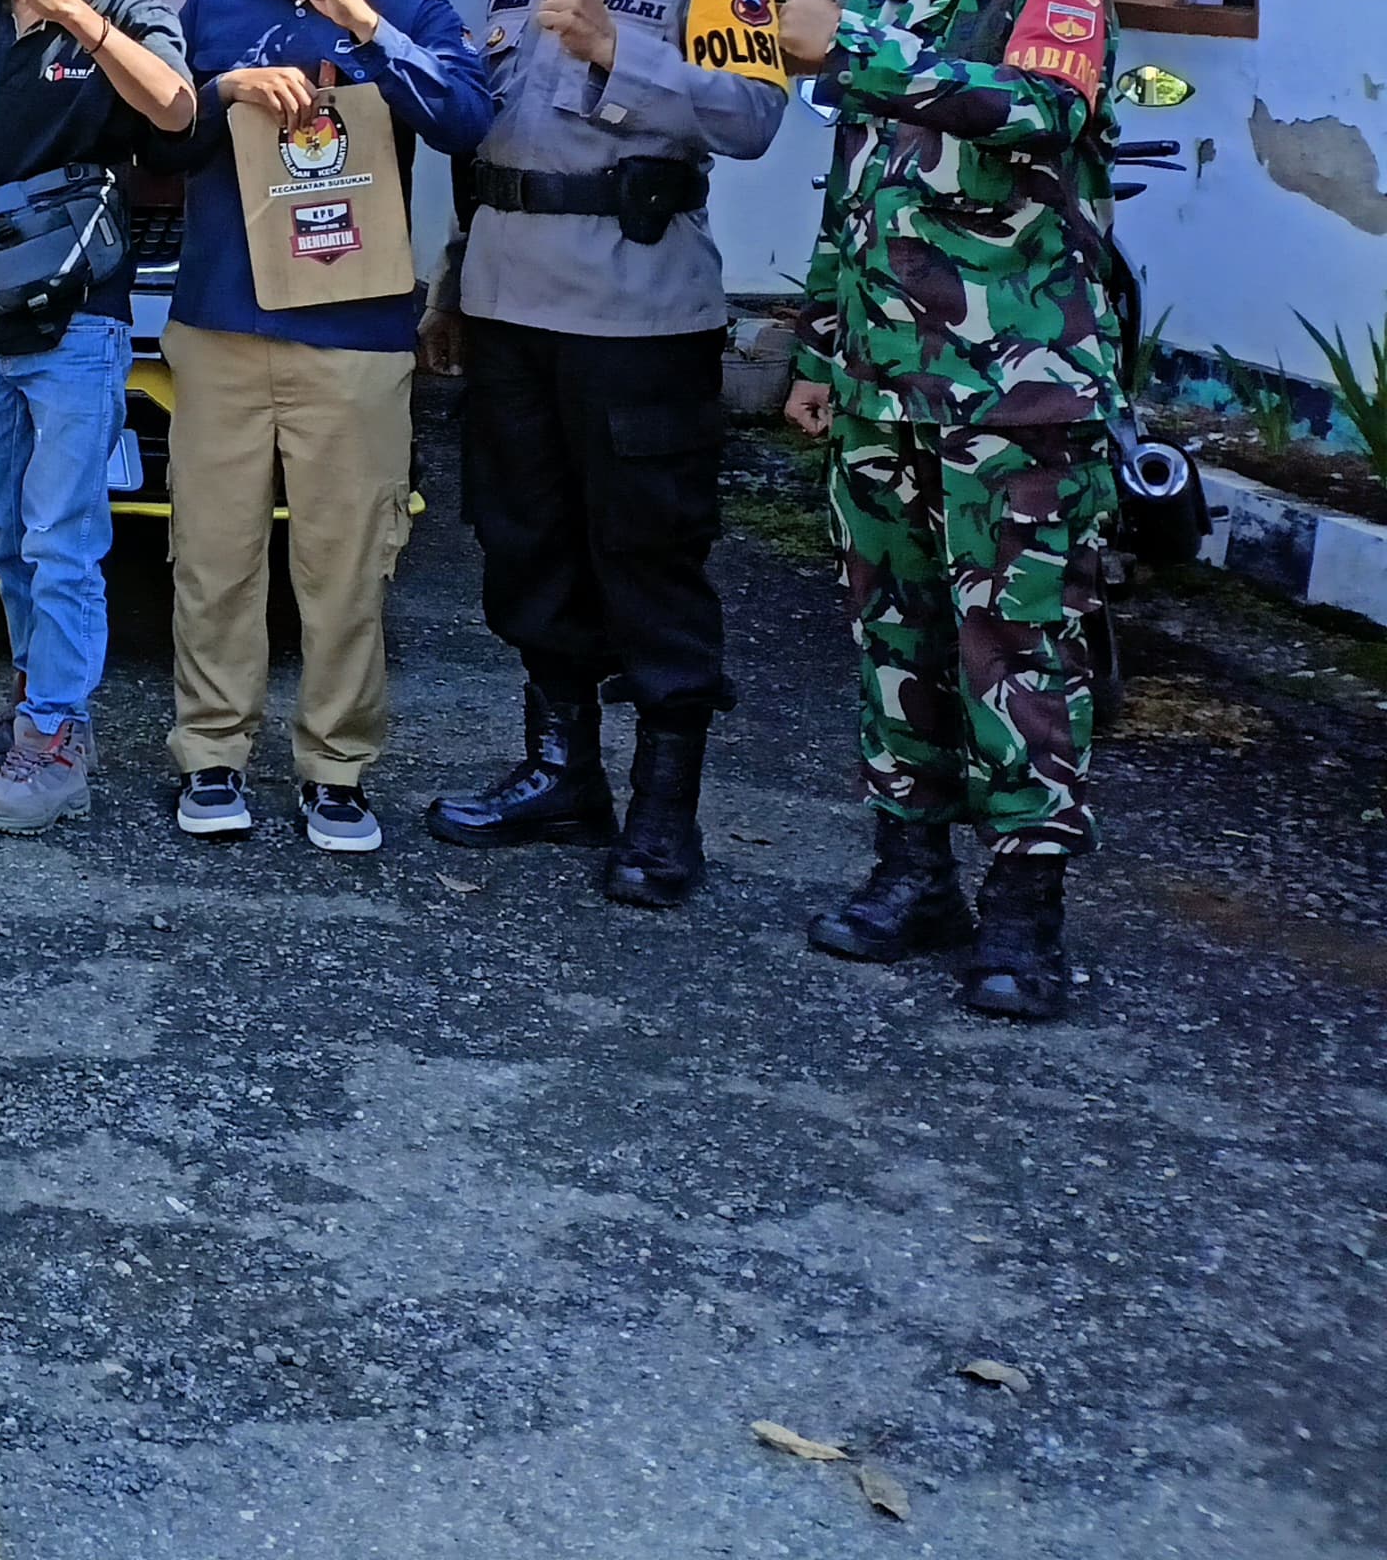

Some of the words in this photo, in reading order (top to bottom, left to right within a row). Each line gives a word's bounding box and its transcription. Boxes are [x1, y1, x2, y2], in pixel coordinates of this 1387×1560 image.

[694, 27, 780, 70] POLISI
[271, 182, 325, 194] KECAMATAN
[328, 175, 371, 187] SUSUKAN
[313, 209, 334, 219] KPU
